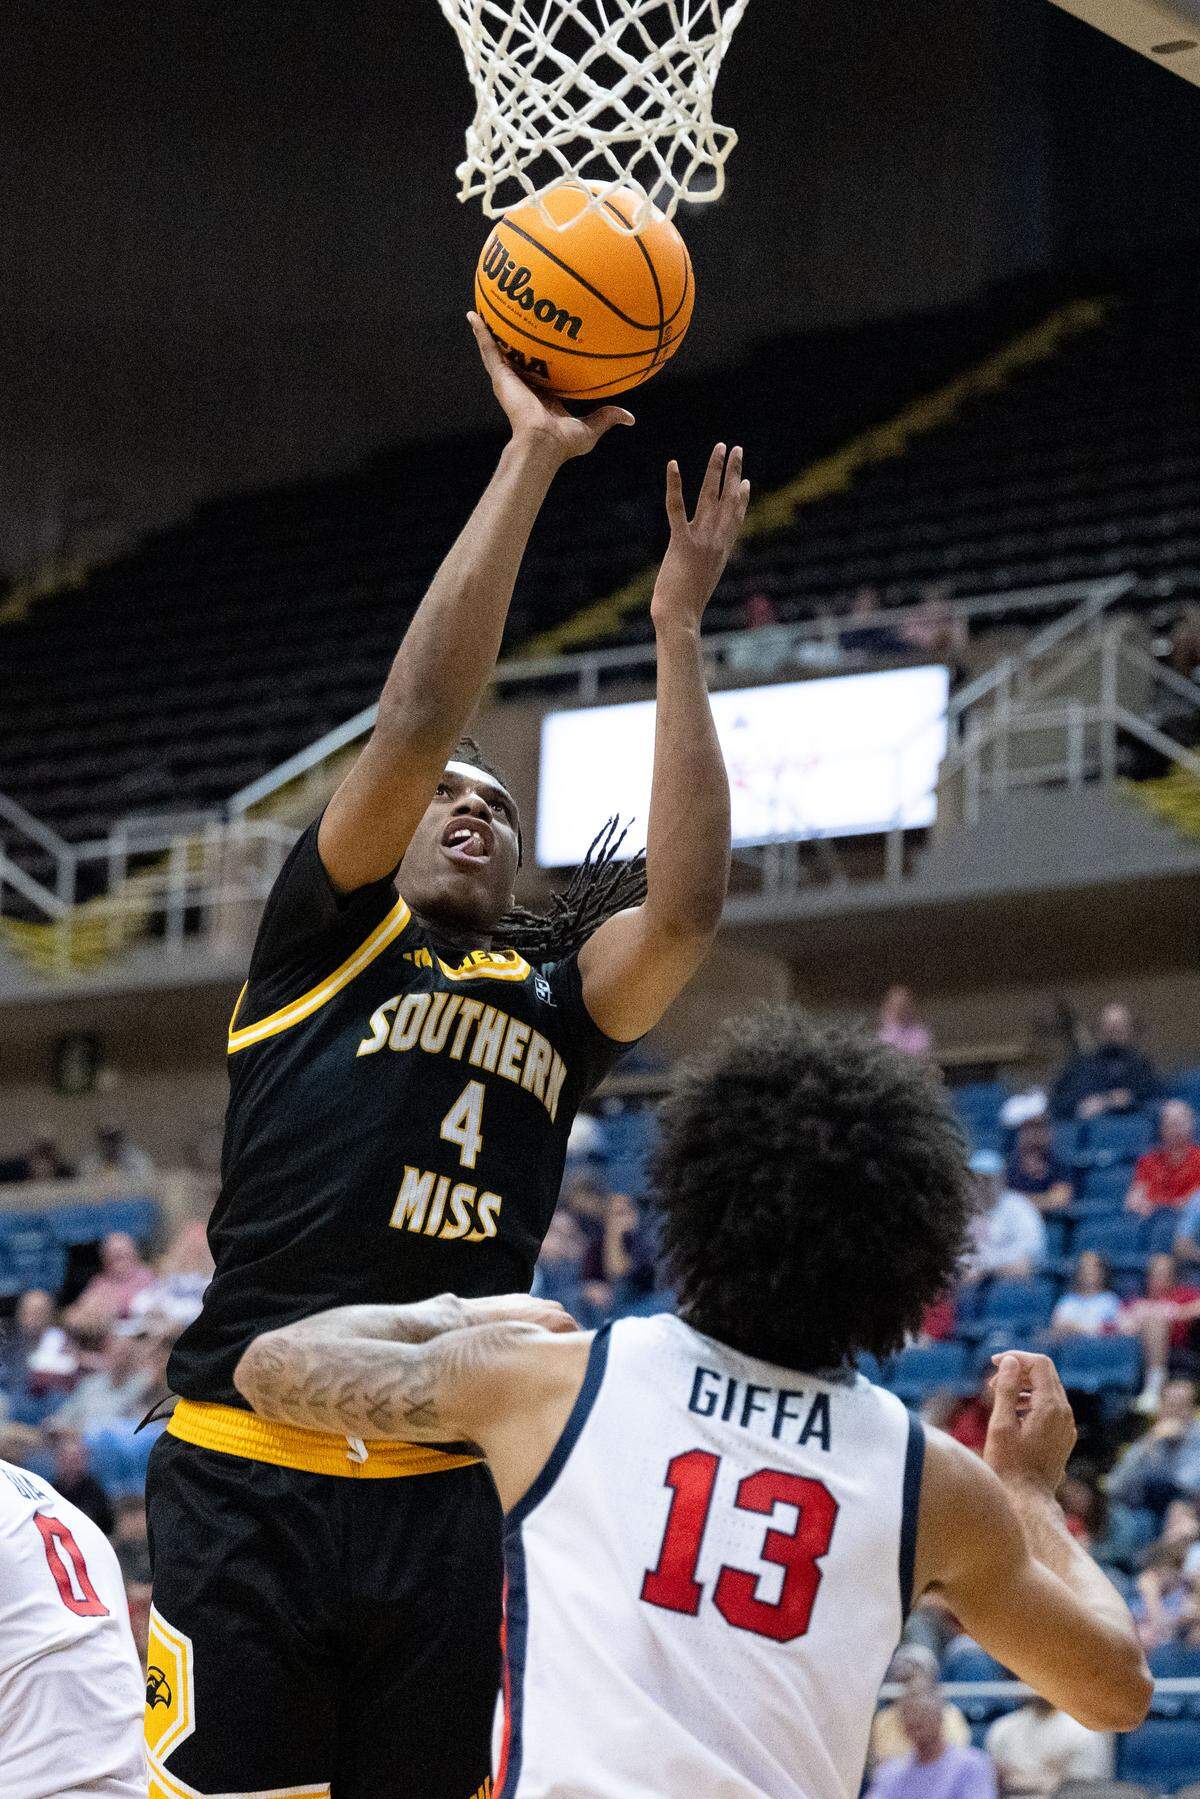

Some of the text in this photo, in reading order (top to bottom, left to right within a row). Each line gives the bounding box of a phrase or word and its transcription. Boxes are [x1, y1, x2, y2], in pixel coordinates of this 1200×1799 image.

[482, 234, 584, 341] Wilson
[356, 992, 567, 1125] SOUTHERN
[440, 1079, 486, 1169] 4
[389, 1165, 502, 1242] MISS
[688, 1366, 831, 1451] GIFFA
[639, 1448, 840, 1643] 13
